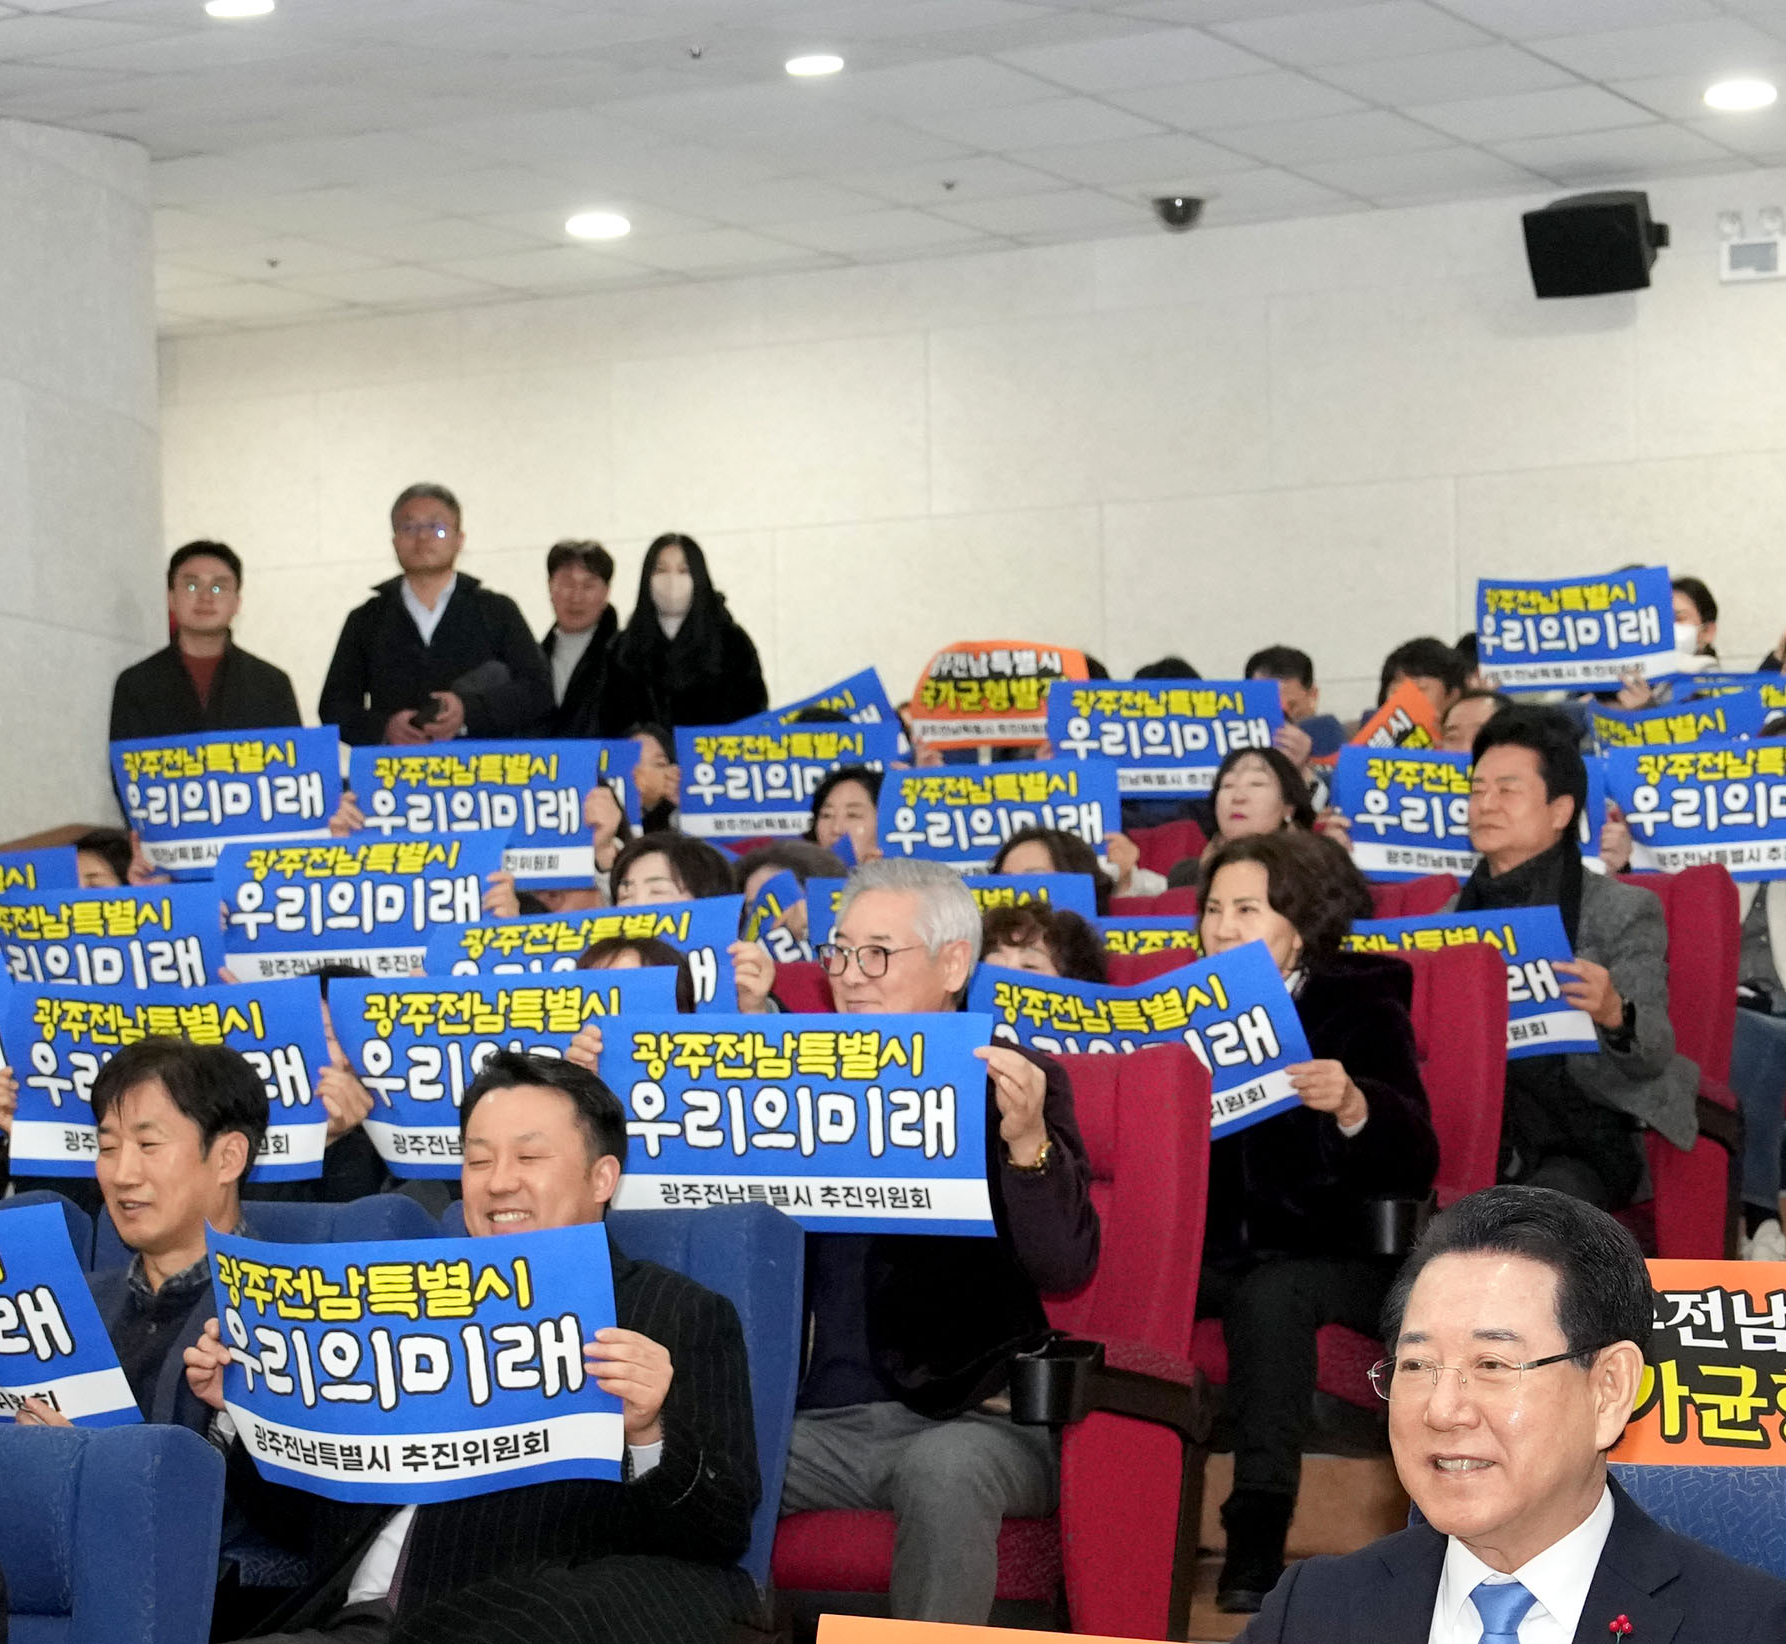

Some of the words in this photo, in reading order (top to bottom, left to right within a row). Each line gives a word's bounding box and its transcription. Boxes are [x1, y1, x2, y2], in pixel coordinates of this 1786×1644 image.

[1479, 605, 1661, 655] 우리의미래
[1071, 689, 1244, 718] 광주전남특별시
[123, 740, 296, 781] 광주전남특별시
[694, 732, 864, 763] 광주전남특별시
[1060, 718, 1271, 760] 우리의미래
[374, 753, 558, 790] 광주전남특별시
[900, 771, 1078, 807] 광주전남특별시
[1368, 758, 1473, 793] 광주전남
[126, 772, 324, 830] 우리의미래
[364, 786, 581, 836] 우리의미래
[246, 840, 461, 882] 광주전남특별시
[230, 874, 480, 942] 우리의미래
[364, 987, 620, 1038] 광주전남특별시
[994, 974, 1229, 1034] 광주전남특별시
[632, 1031, 924, 1082] 광주전남특별시
[392, 1132, 463, 1157] 광주전남
[624, 1083, 958, 1160] 우리의미래
[818, 1181, 933, 1211] 추진위원회
[217, 1256, 533, 1321] 광주전남특별시
[224, 1312, 586, 1411] 우리의미래
[253, 1422, 392, 1474] 광주전남특별시
[401, 1429, 552, 1474] 추진위원회
